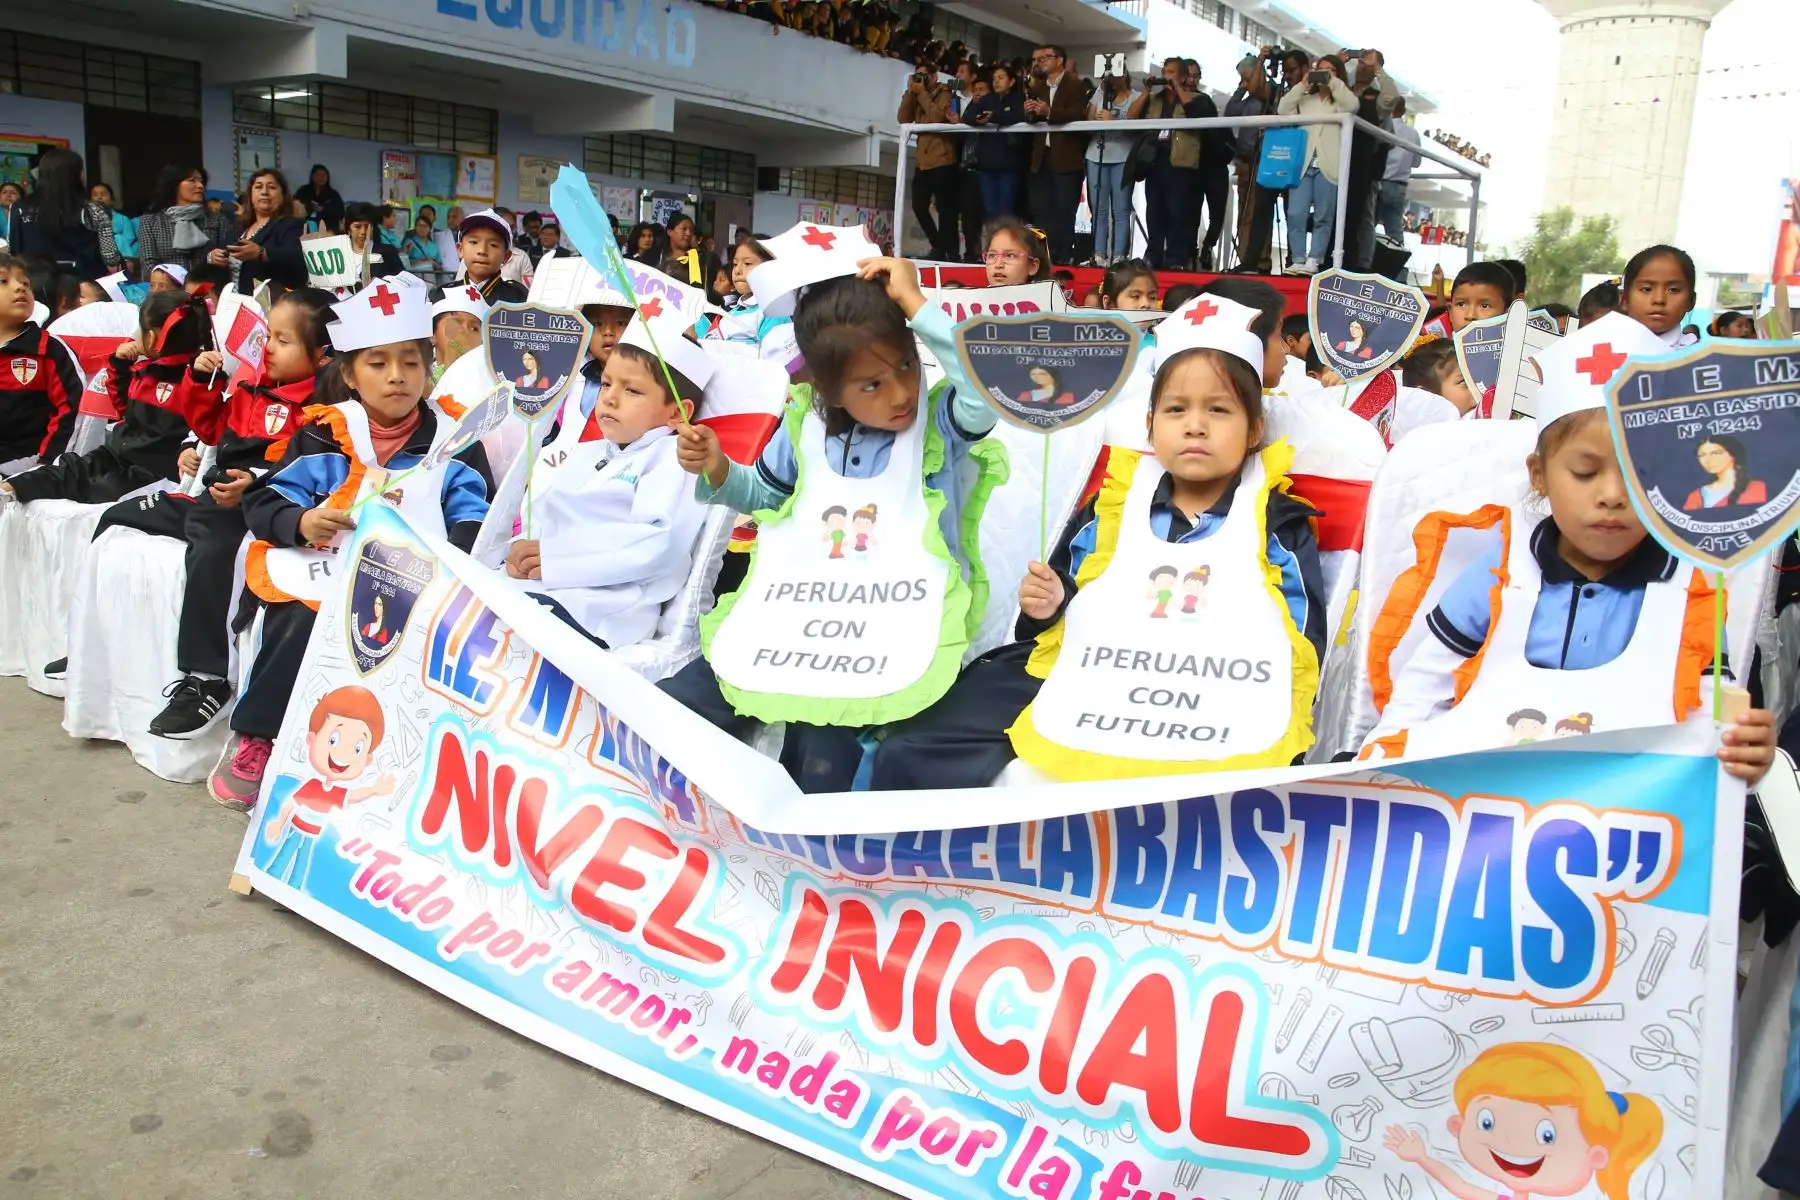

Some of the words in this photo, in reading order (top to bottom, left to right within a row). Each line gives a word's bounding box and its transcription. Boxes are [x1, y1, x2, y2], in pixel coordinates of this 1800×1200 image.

[437, 0, 696, 68] QUIDAD
[595, 267, 684, 311] MOR
[1333, 276, 1342, 291] I
[1360, 283, 1375, 299] E
[500, 310, 507, 325] I
[522, 312, 536, 328] E
[1320, 292, 1362, 310] MICAELA
[1363, 303, 1414, 323] BASTIDAS
[490, 328, 530, 341] MICAELA
[530, 332, 579, 345] BASTIDAS
[986, 324, 998, 341] I
[1030, 325, 1051, 342] E
[969, 344, 1041, 356] MICAELA
[1043, 346, 1123, 357] BASTIDAS
[1465, 343, 1503, 354] MICAEL
[1336, 365, 1359, 377] ATE
[1638, 374, 1653, 401] I
[1692, 364, 1722, 394] E
[1624, 402, 1711, 429] MICAELA
[1713, 391, 1800, 417] BASTID
[1706, 415, 1763, 437] 1244
[1649, 493, 1688, 527] ESTUDIO
[1689, 517, 1763, 534] DISCIPLINA
[1762, 474, 1800, 522] TRIUNF
[1696, 532, 1752, 551] ATE
[764, 578, 927, 605] ¡PERUANOS
[803, 618, 867, 639] CON
[753, 648, 889, 676] FUTURO!
[1080, 646, 1273, 684] ¡PERUANOS
[1128, 686, 1201, 711] CON
[1075, 712, 1231, 744] FUTURO!
[420, 730, 727, 965] NIVEL
[769, 887, 1311, 1157] INICIAL
[443, 911, 552, 969] por
[551, 960, 699, 1055] amor,
[720, 1030, 864, 1121] nada
[869, 1094, 999, 1168] por
[1006, 1125, 1072, 1200] la
